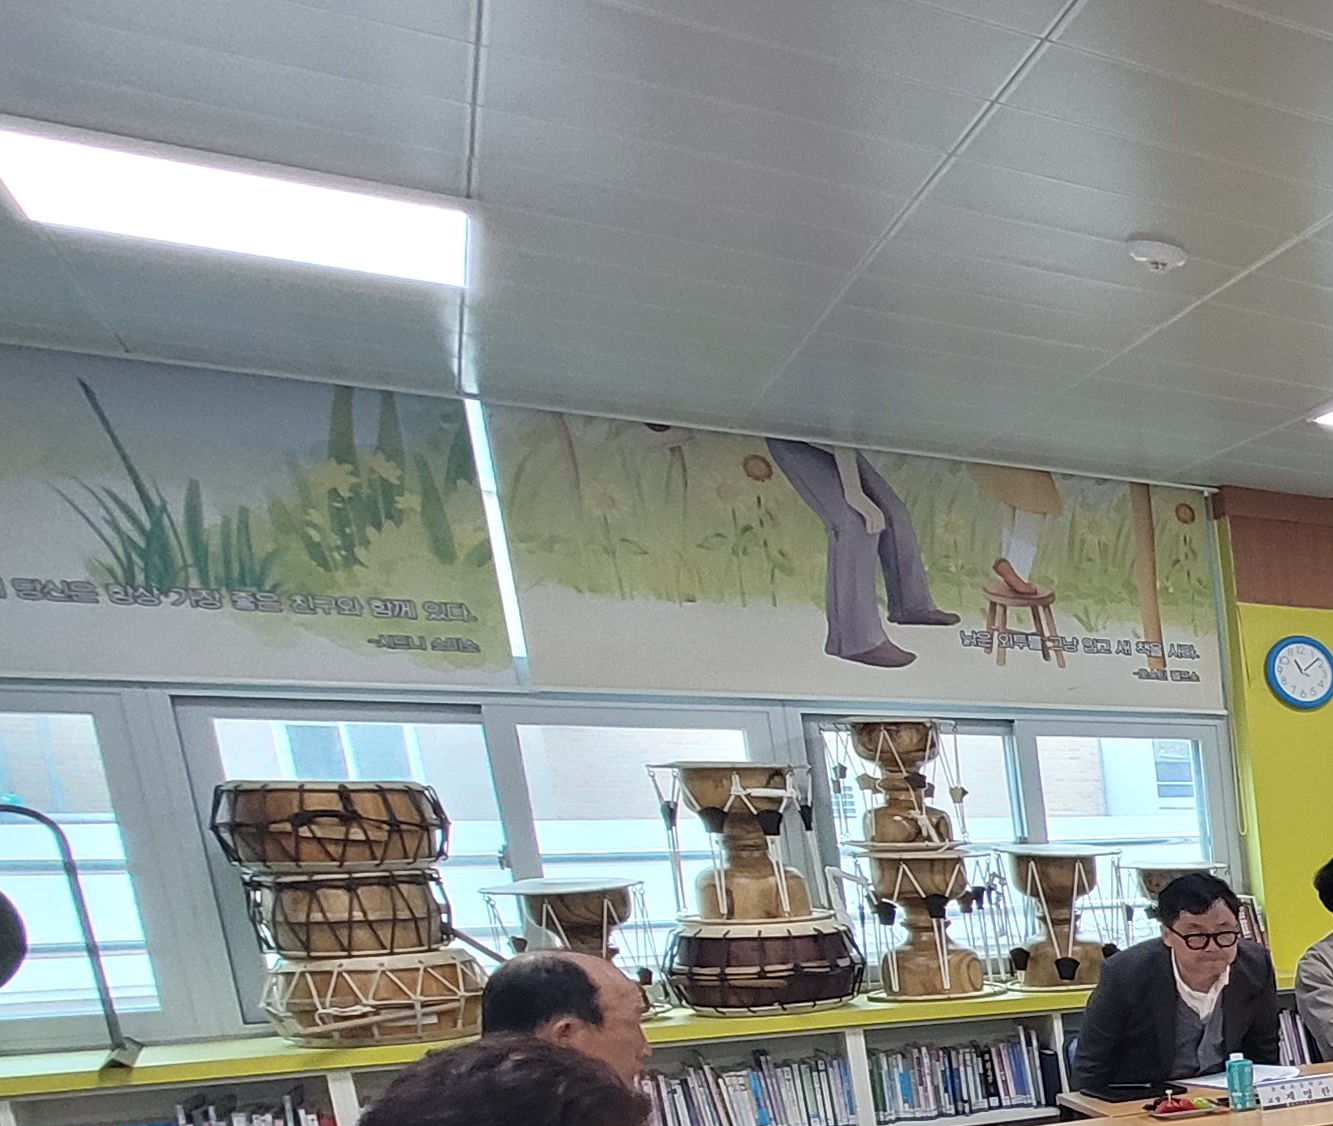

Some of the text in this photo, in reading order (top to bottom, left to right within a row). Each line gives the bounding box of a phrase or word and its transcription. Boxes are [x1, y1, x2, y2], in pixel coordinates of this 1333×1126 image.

[11, 578, 99, 604] 당신은
[105, 583, 163, 606] 항상
[170, 587, 224, 610] 가장
[231, 590, 283, 613] 좋은
[290, 593, 363, 617] 친구와
[370, 597, 418, 620] 함께
[424, 601, 478, 622] 있다.
[1115, 639, 1132, 656] 새
